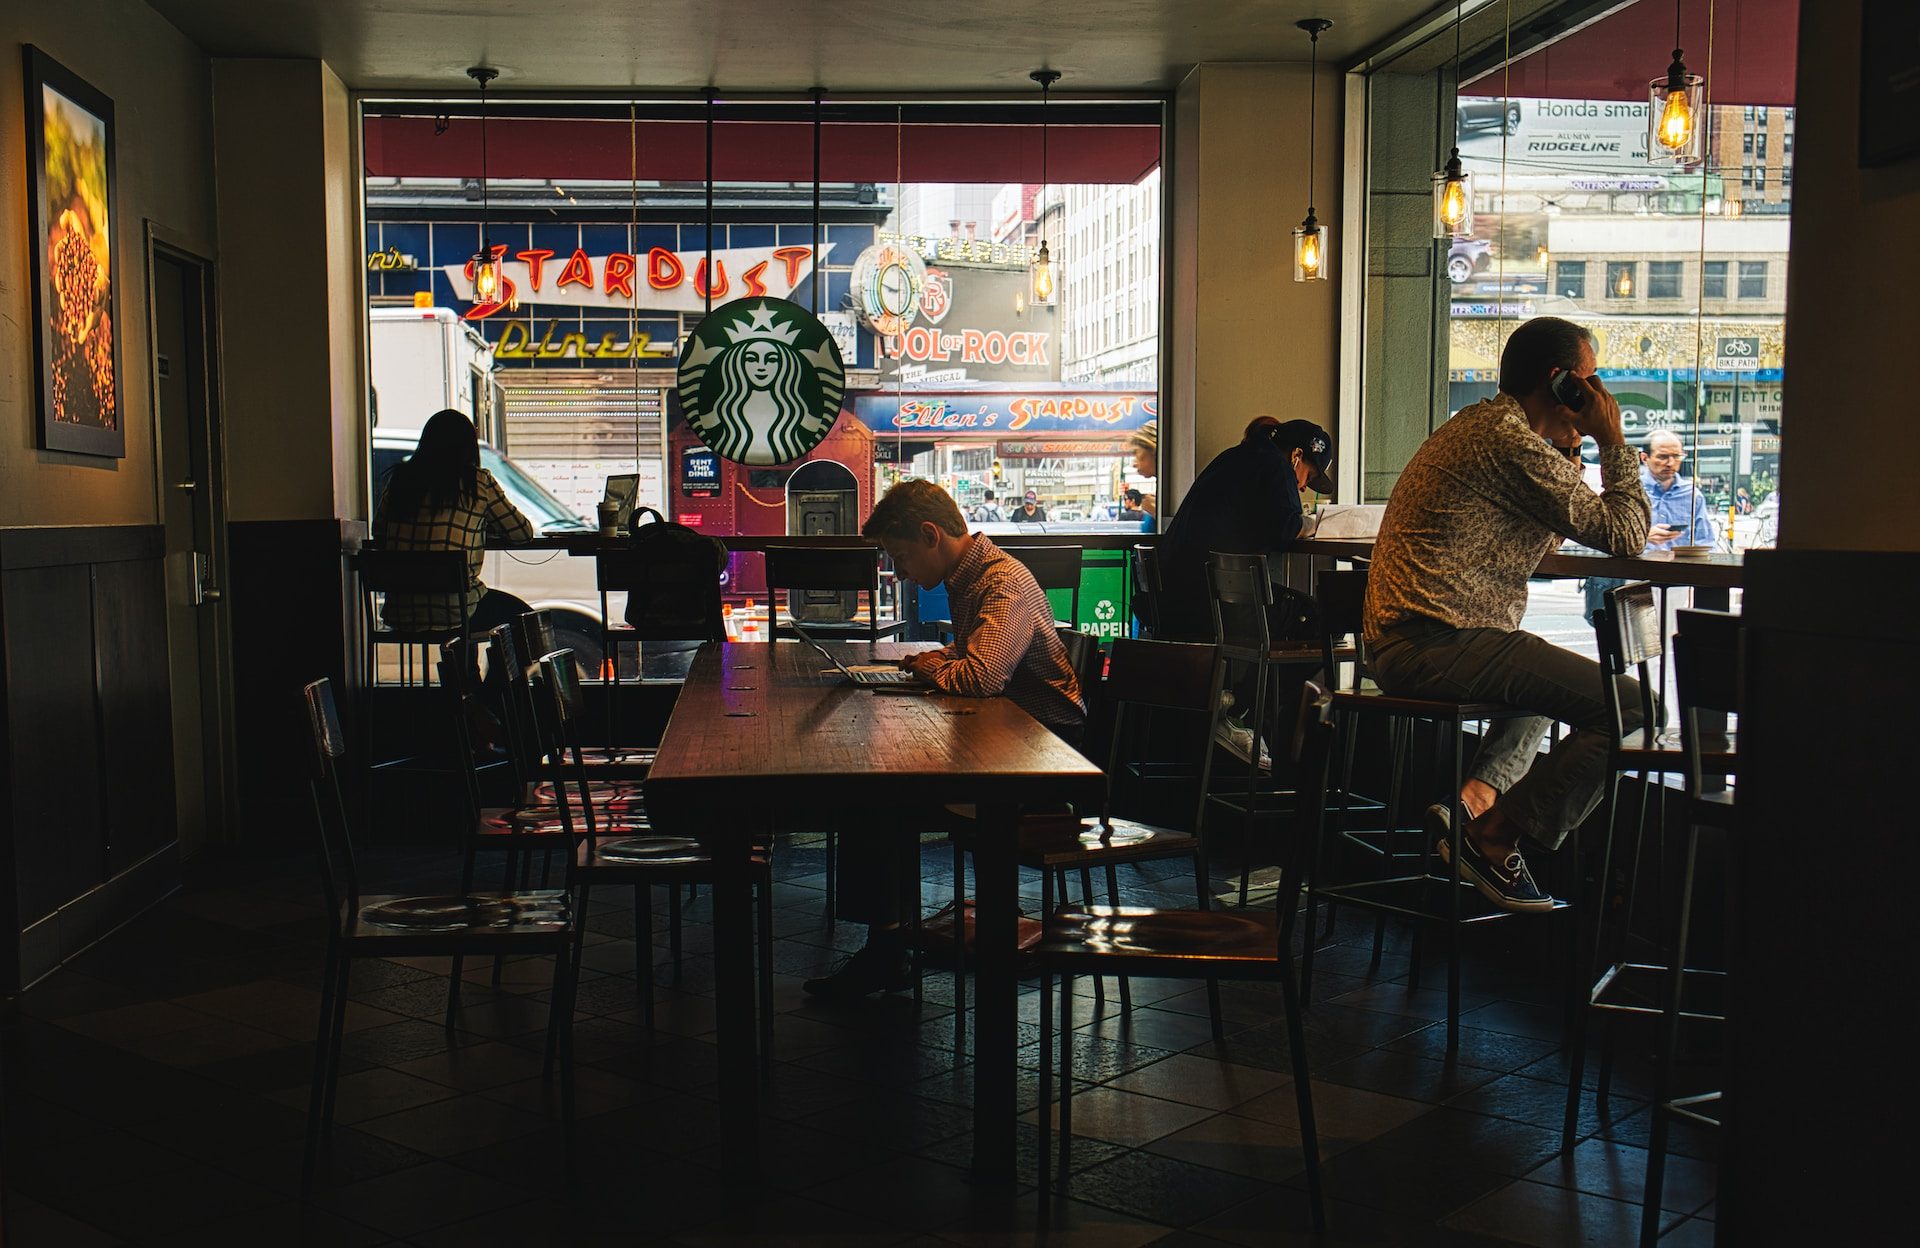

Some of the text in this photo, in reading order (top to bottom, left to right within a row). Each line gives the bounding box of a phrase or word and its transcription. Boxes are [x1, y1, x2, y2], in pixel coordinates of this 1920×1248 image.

[1537, 100, 1598, 117] Honda
[1527, 142, 1621, 151] RIDGELINE
[464, 244, 812, 320] STARDUST
[880, 326, 1049, 366] OOL OF ROCK
[1718, 359, 1757, 368] BIKE PATH
[904, 369, 923, 379] THE
[1712, 390, 1768, 403] EMETT
[891, 400, 999, 428] Ellen's
[1008, 396, 1137, 430] STARDUST
[1645, 409, 1686, 421] OPEN
[688, 470, 715, 478] DINER
[1080, 622, 1129, 637] PAPER
